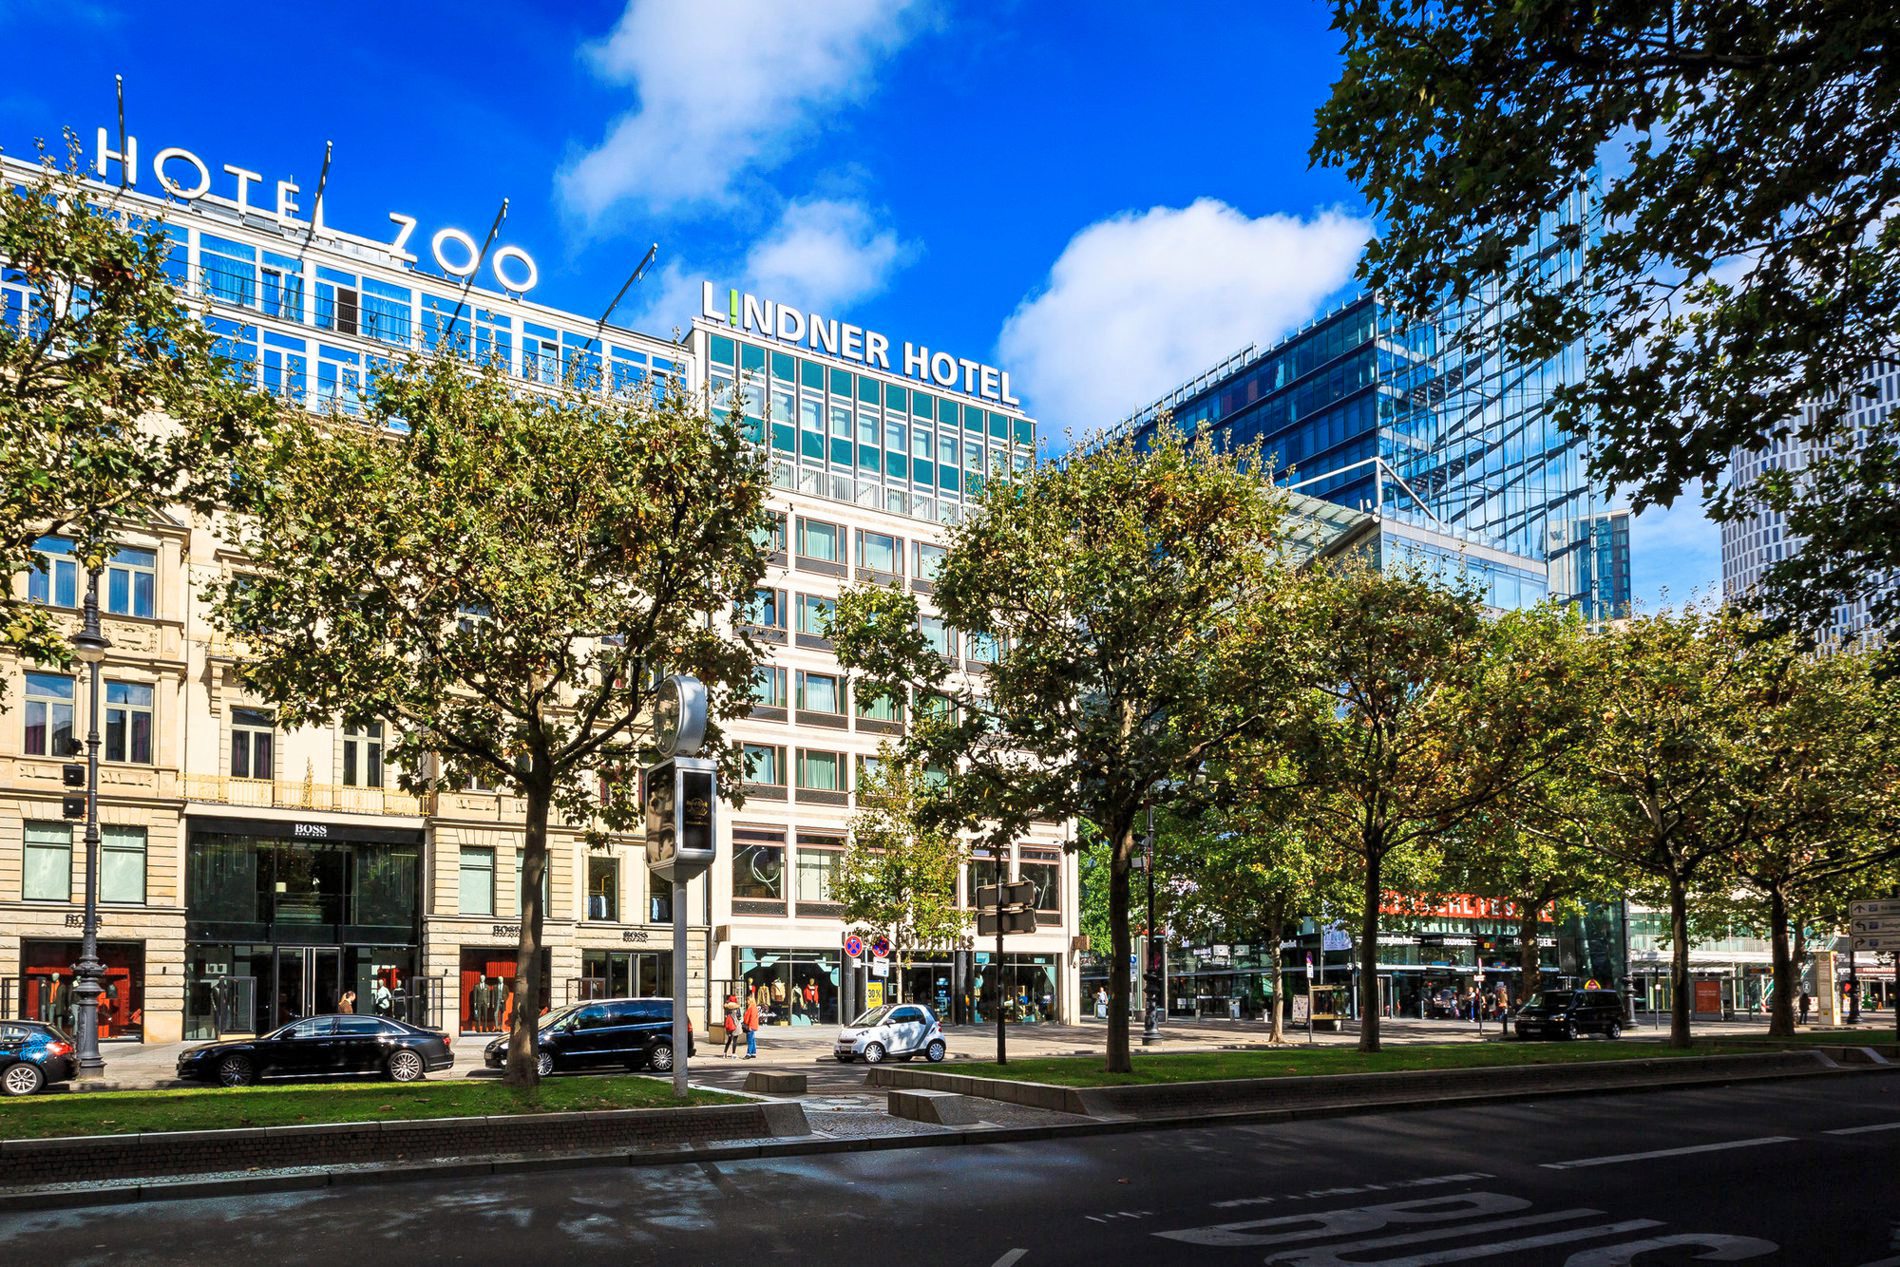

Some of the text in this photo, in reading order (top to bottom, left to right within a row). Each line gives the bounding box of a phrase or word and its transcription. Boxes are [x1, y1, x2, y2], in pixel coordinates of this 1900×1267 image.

[97, 126, 538, 294] HOTEL ZOO
[903, 341, 1020, 407] HOTEL
[294, 823, 328, 835] BOSS
[66, 913, 103, 926] BOS
